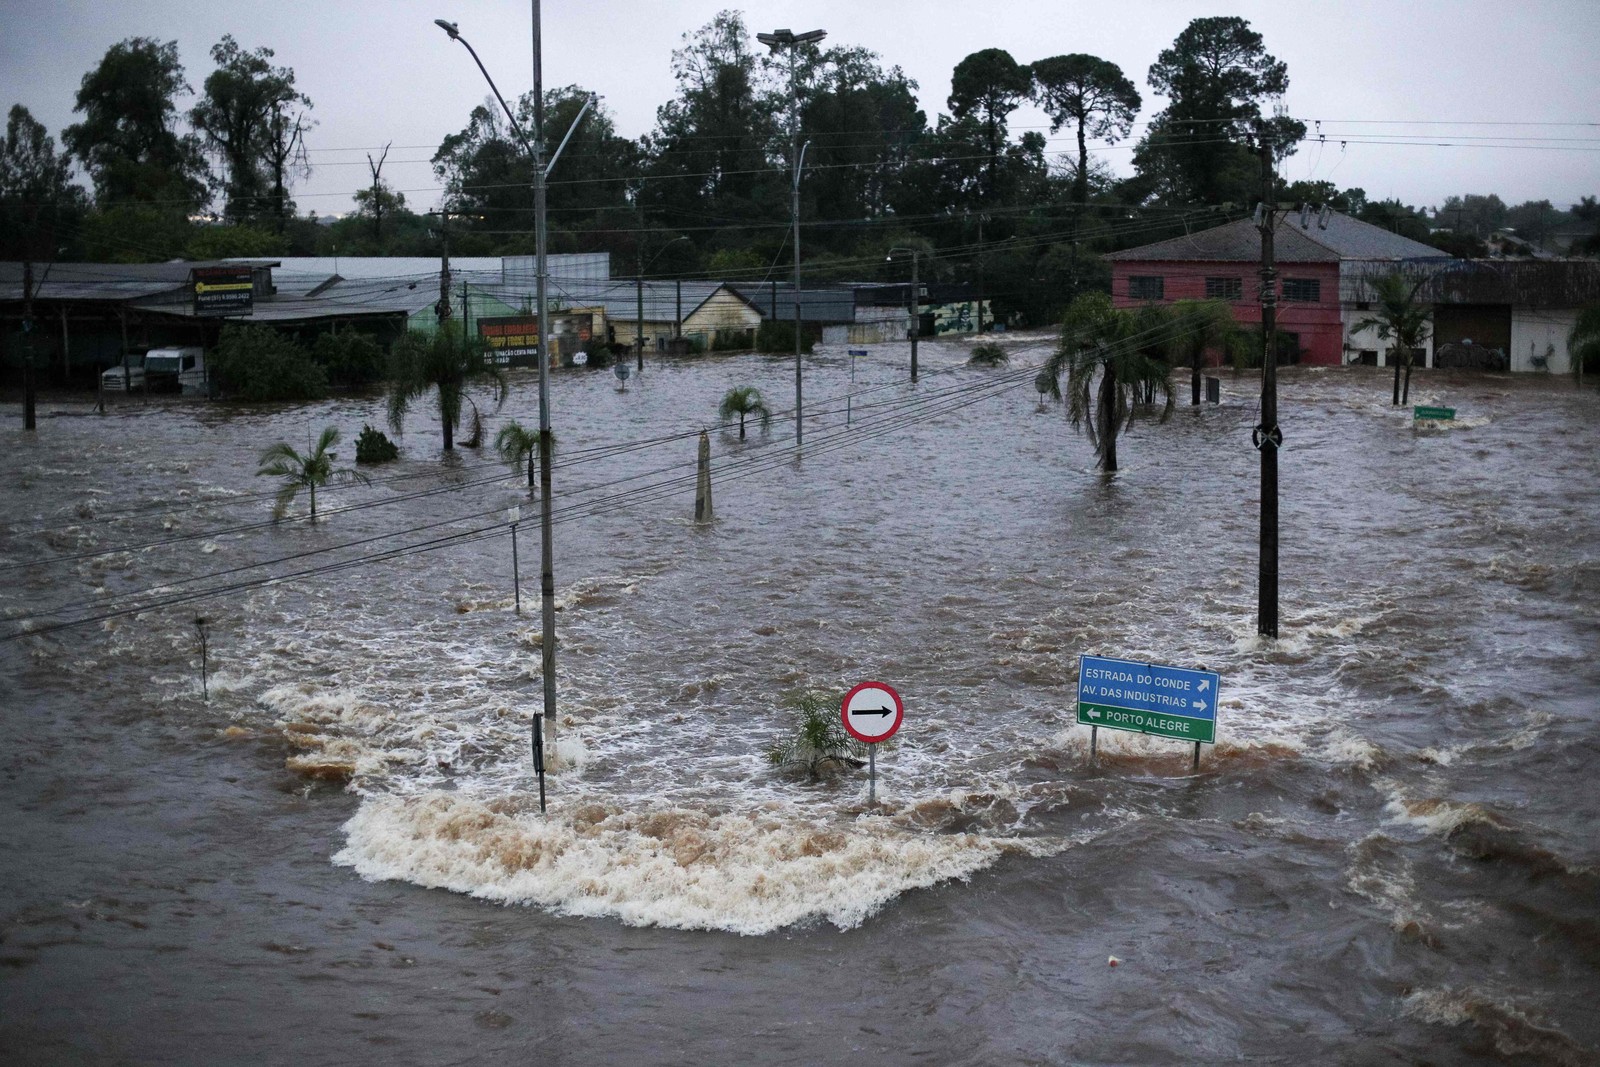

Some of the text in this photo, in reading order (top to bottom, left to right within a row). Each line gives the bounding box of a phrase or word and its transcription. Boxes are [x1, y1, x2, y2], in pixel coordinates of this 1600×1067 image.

[1085, 668, 1191, 691] ESTRADA DO CONDE
[1082, 685, 1187, 708] AV. DAS INDUSTRIAS
[1106, 711, 1190, 733] PORTO ALEGRE
